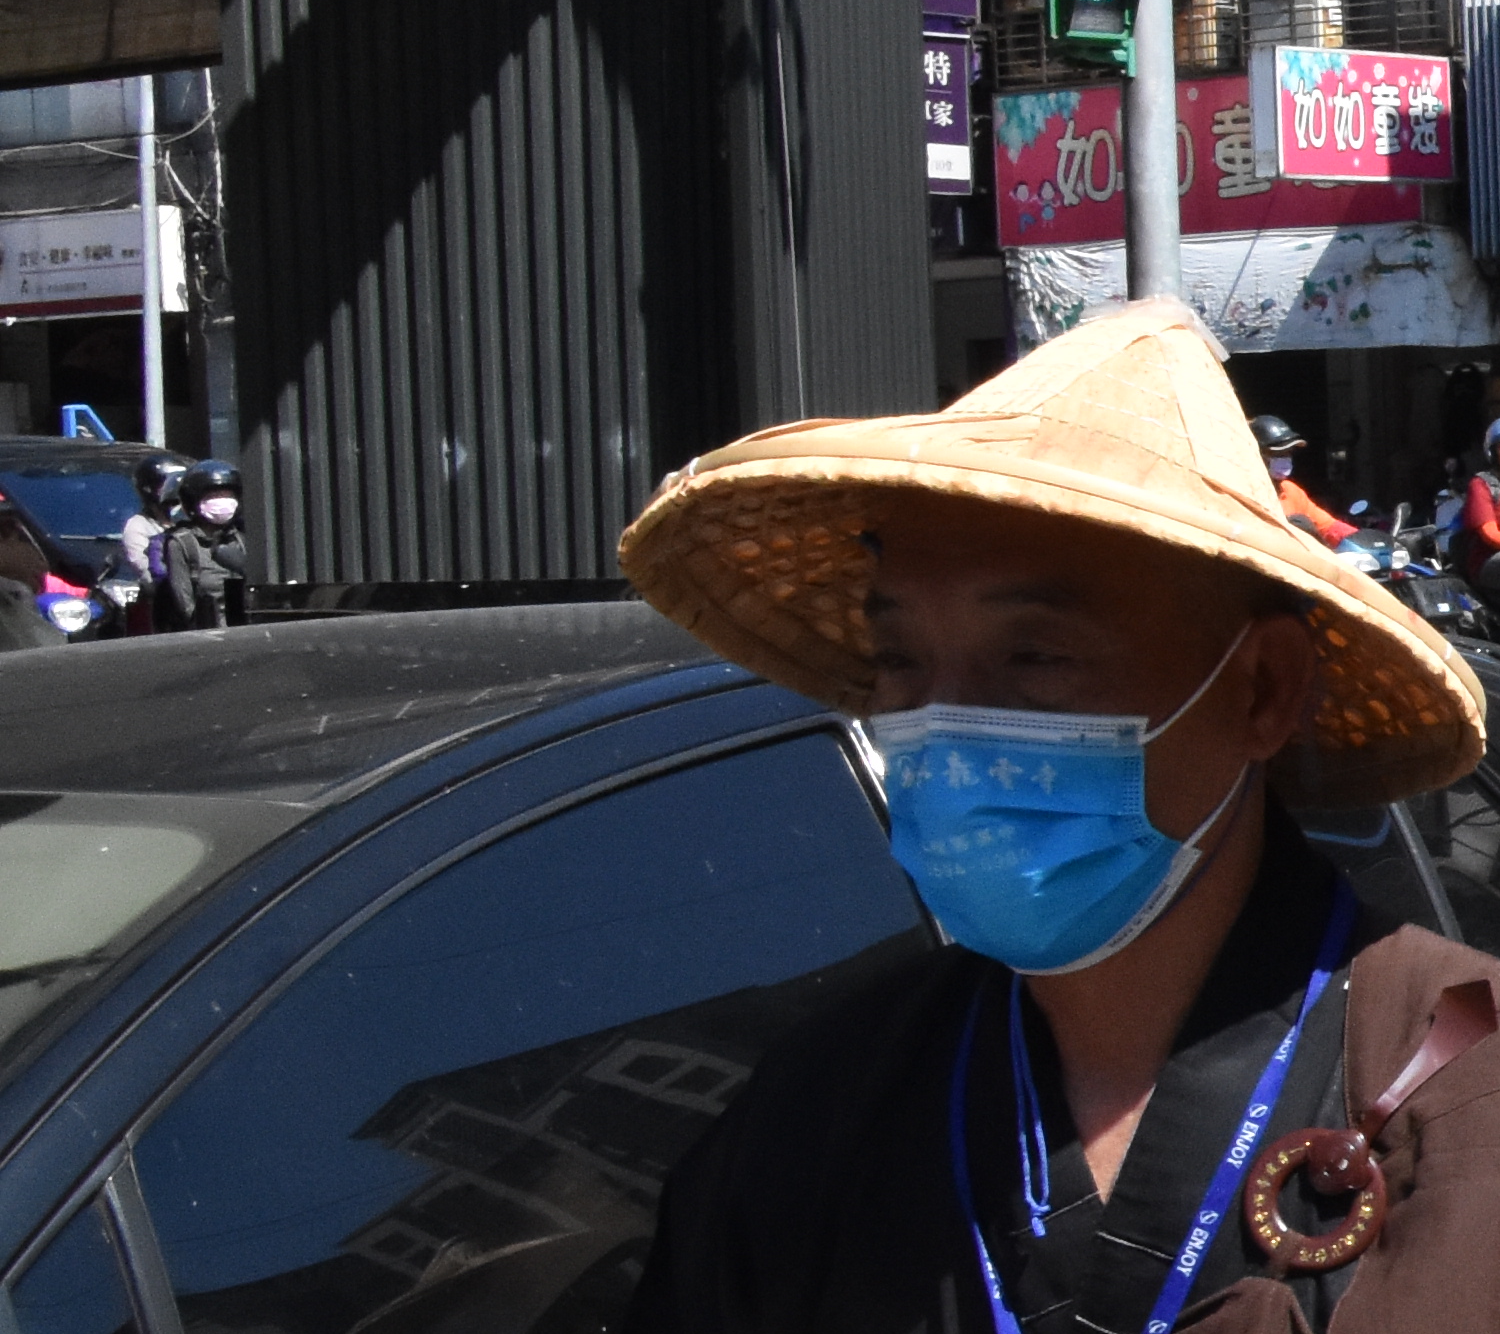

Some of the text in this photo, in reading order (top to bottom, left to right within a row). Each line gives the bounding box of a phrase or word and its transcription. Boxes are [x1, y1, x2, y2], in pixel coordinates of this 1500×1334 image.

[1294, 78, 1441, 155] 如如童裝
[1227, 1120, 1259, 1169] ENJOY
[1177, 1228, 1210, 1278] ENJOY
